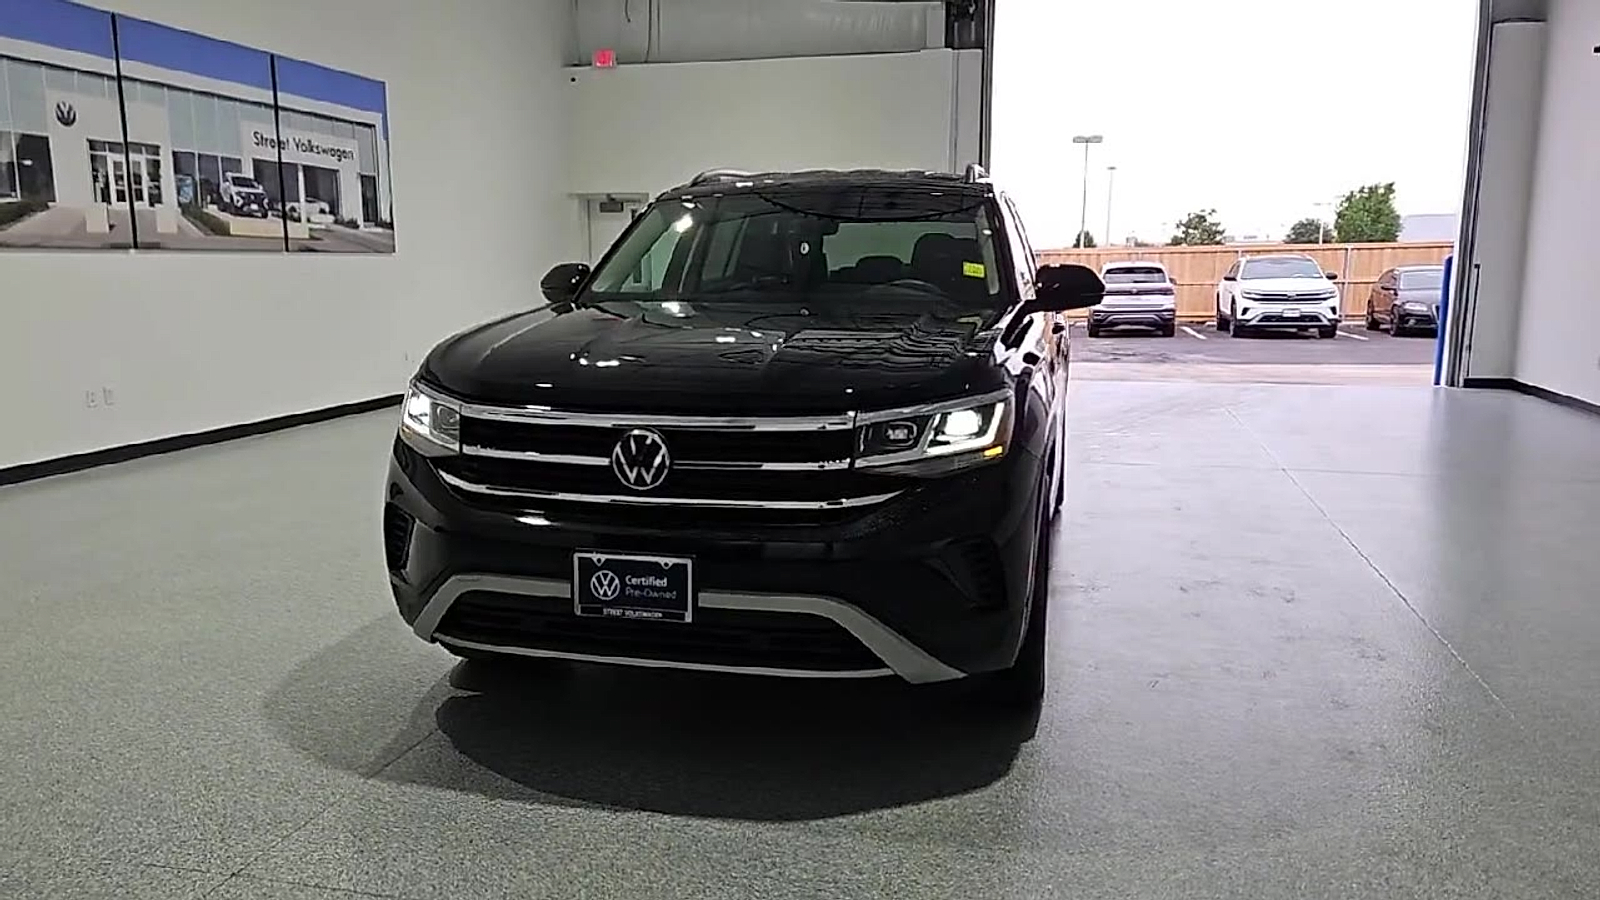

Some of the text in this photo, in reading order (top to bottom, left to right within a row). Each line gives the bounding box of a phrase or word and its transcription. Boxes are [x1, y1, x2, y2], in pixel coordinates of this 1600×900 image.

[253, 131, 354, 162] Street Volkswagen
[625, 575, 668, 587] Certified
[625, 586, 677, 599] Pre-Owned
